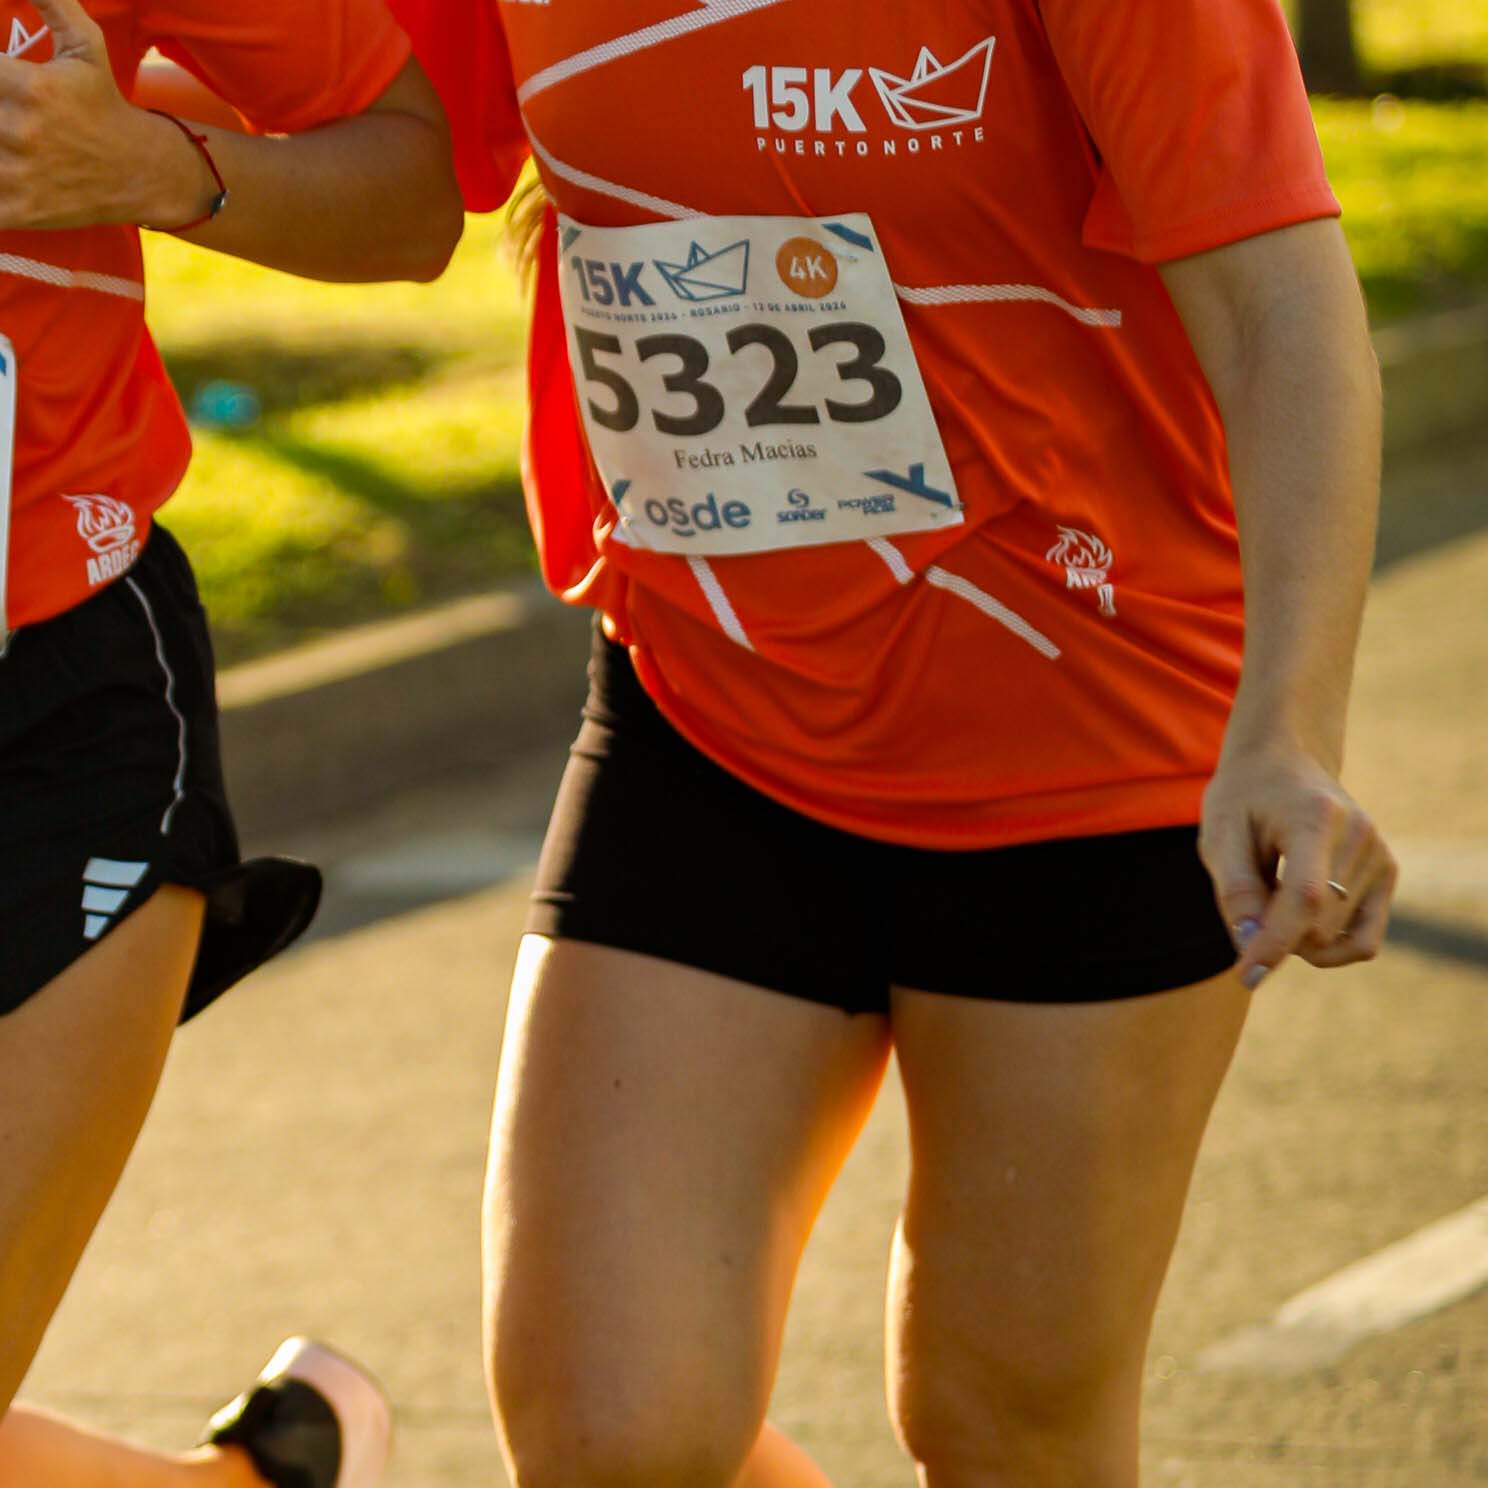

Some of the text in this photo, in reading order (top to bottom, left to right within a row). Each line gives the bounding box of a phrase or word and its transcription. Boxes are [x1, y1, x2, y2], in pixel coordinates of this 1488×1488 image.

[742, 65, 867, 133] 15K
[757, 126, 985, 157] PUERTO NORTE
[571, 255, 655, 306] 15K
[788, 255, 827, 281] 4K
[574, 320, 903, 437] 5323
[674, 448, 735, 469] Fedra
[644, 493, 752, 537] osde
